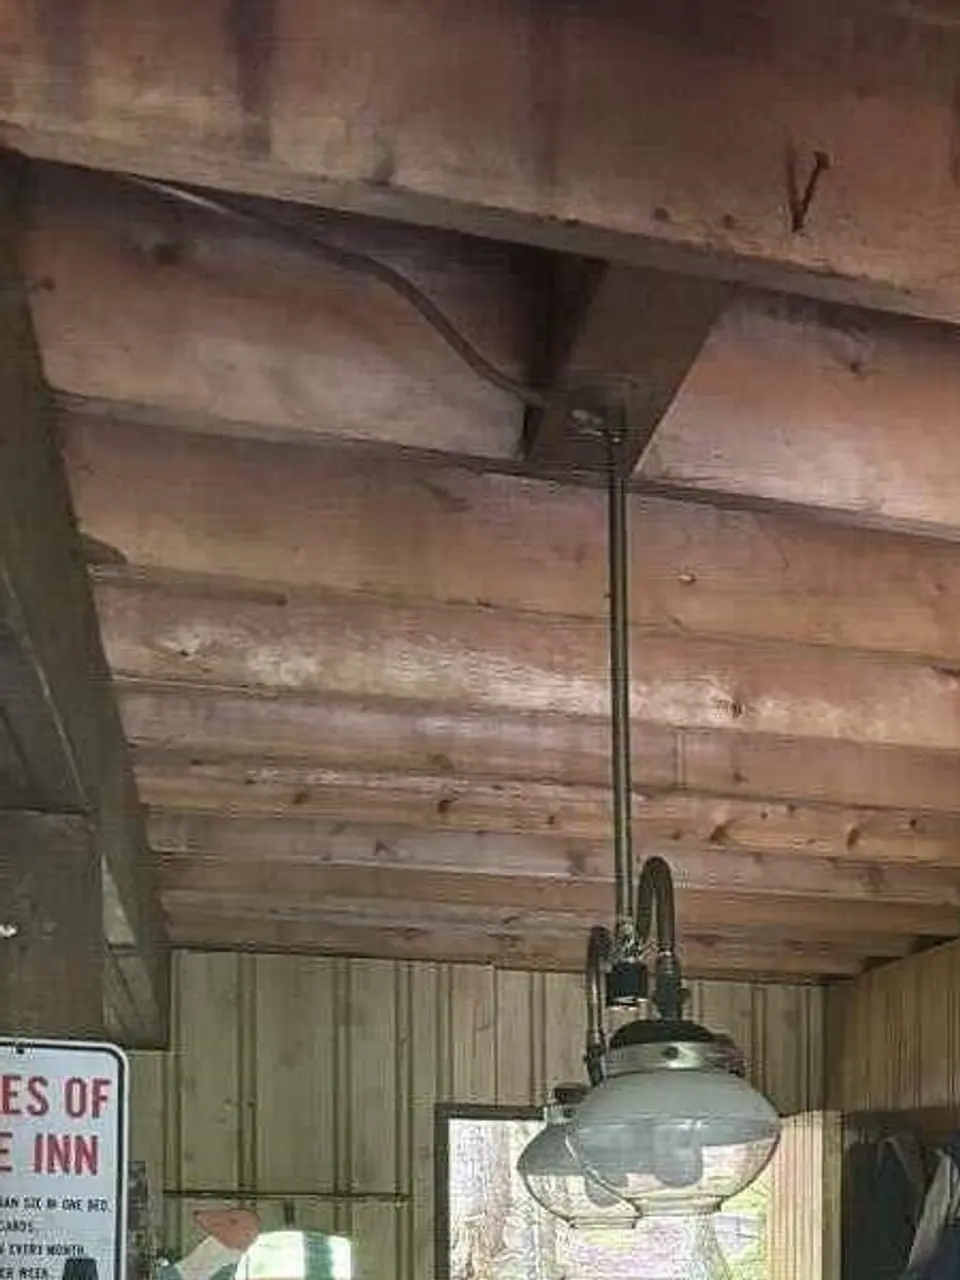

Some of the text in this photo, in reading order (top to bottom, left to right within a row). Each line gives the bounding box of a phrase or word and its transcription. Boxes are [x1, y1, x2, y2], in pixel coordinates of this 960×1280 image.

[1, 1075, 112, 1119] ES OF
[34, 1133, 98, 1176] INN
[61, 1198, 83, 1212] ONE
